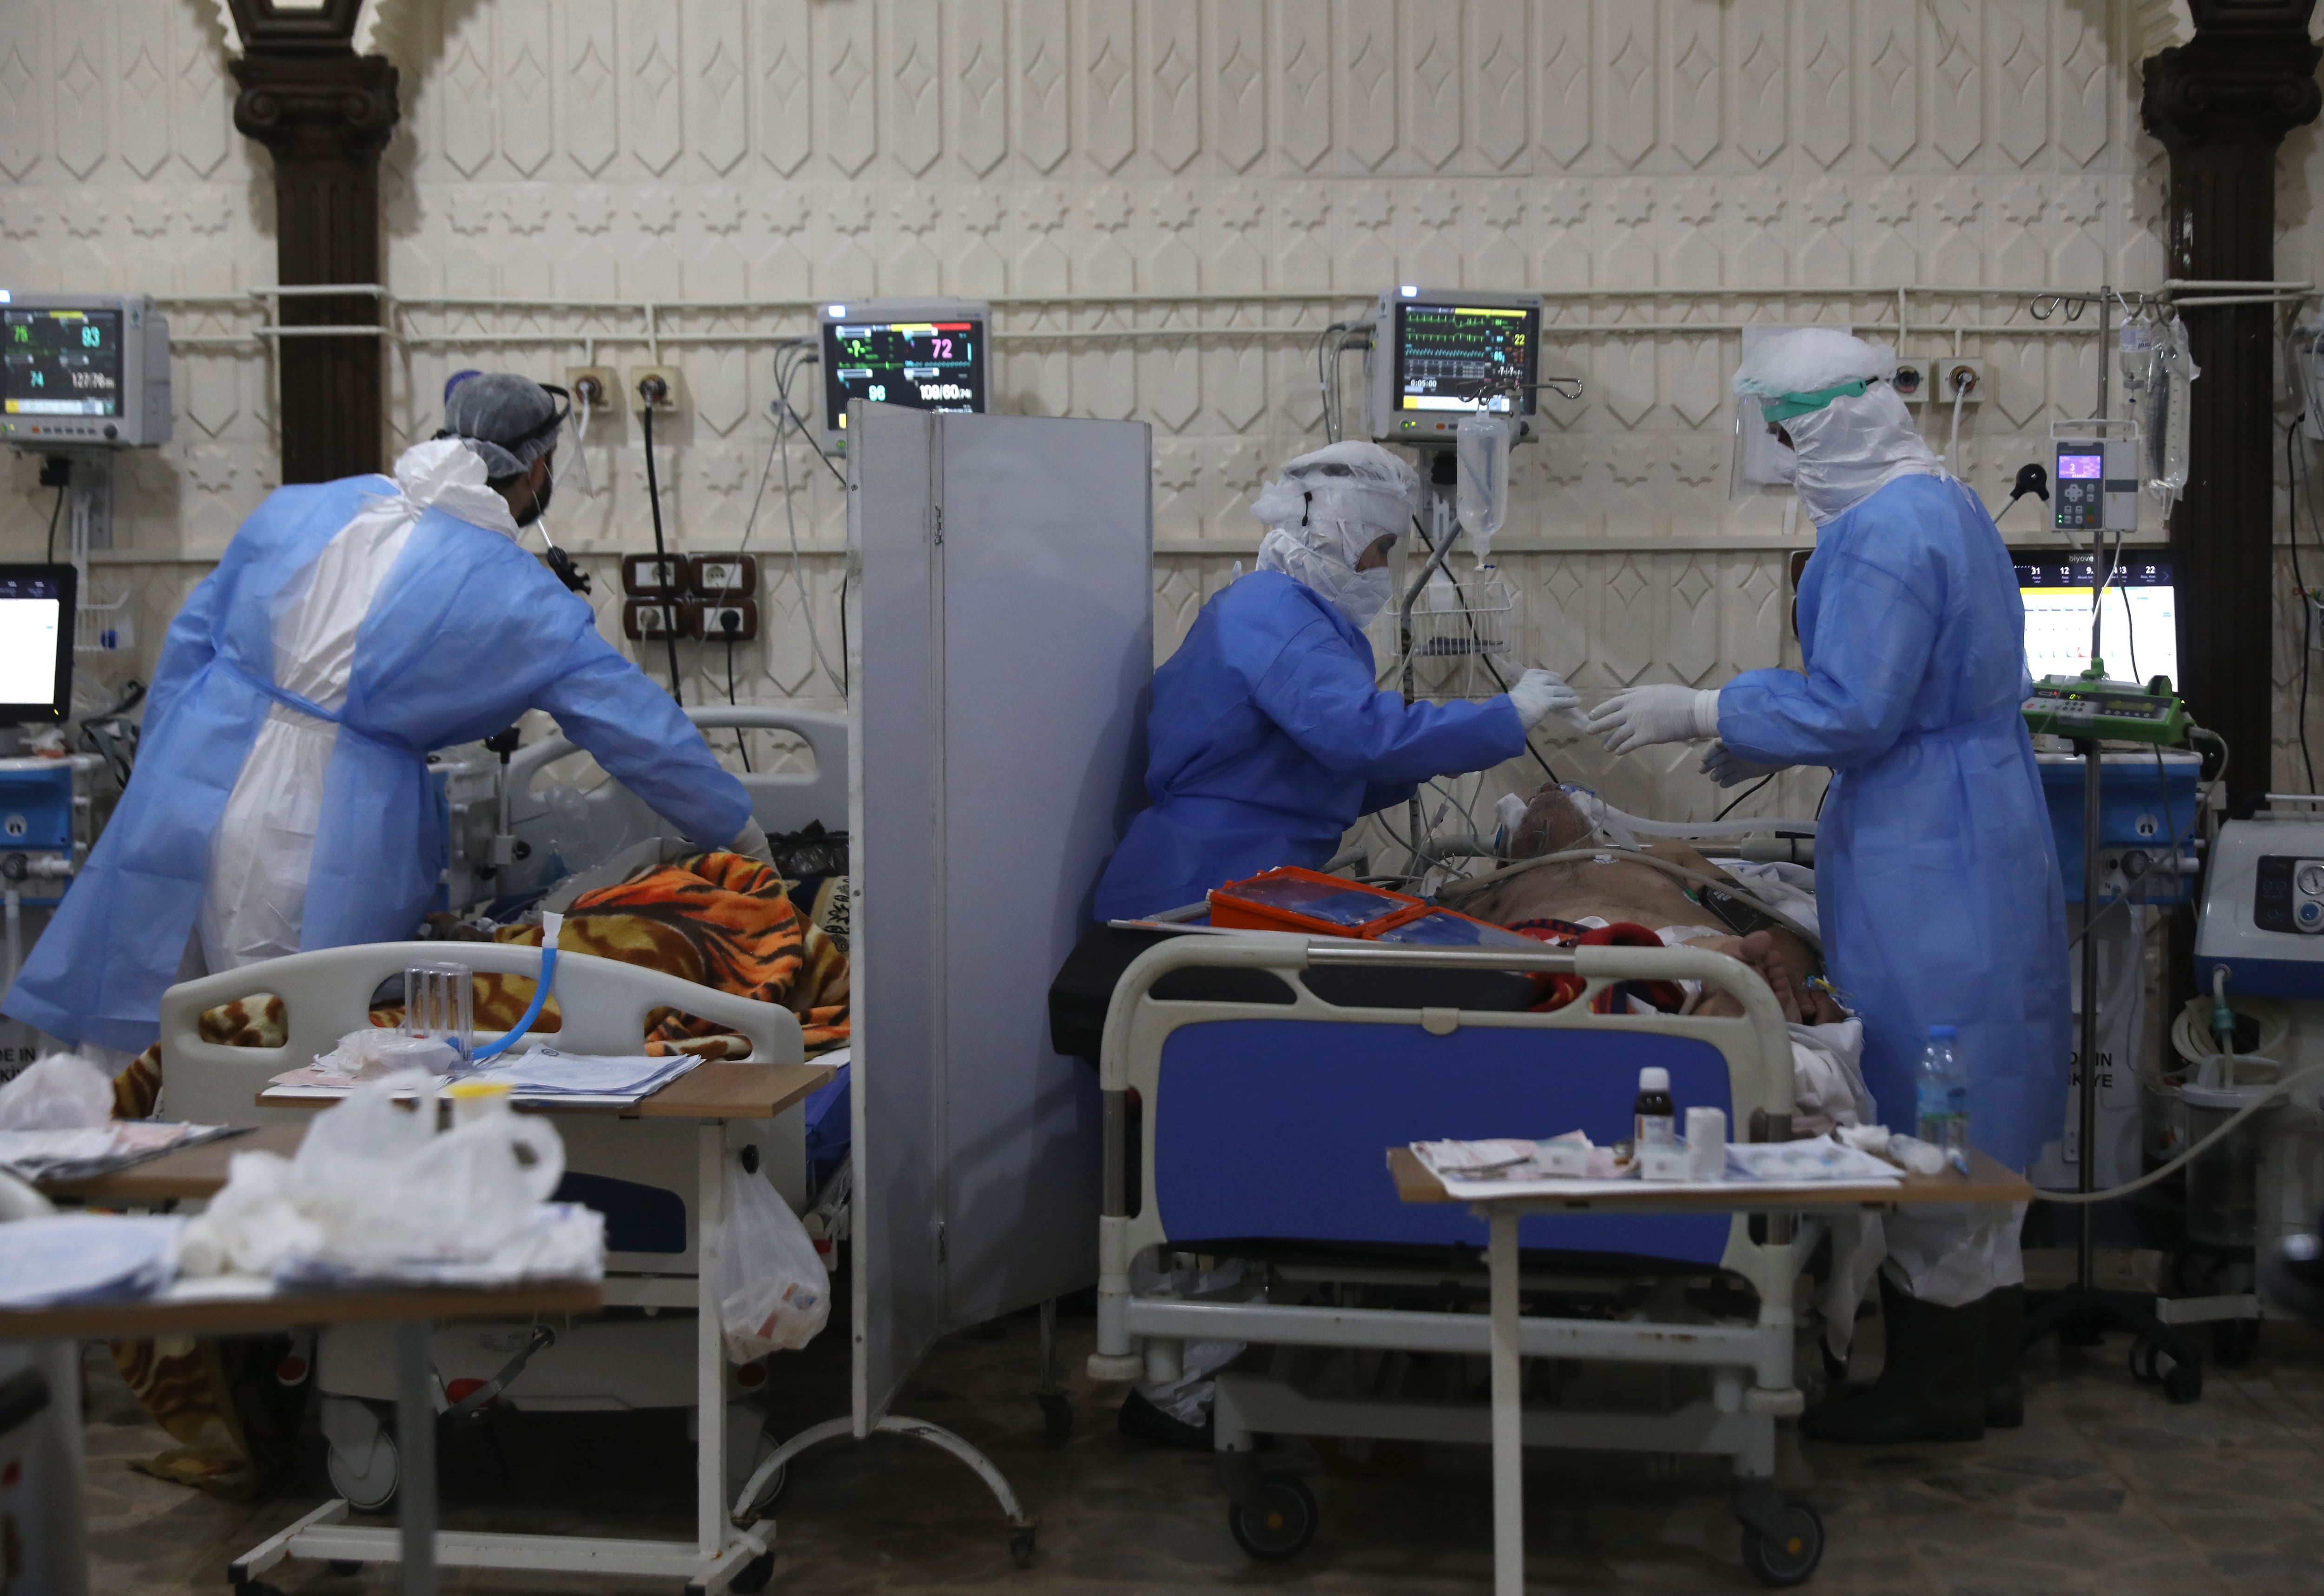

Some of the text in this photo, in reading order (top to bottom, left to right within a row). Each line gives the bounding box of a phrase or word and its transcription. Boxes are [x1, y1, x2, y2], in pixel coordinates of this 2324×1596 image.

[1514, 334, 1525, 346] 22
[931, 338, 953, 359] 72
[1411, 379, 1437, 387] 0:05:00
[2070, 463, 2075, 471] 3
[2031, 567, 2040, 575] 31
[2060, 566, 2070, 575] 12
[2146, 565, 2156, 574] 22
[20, 1046, 36, 1062] IN
[2095, 1053, 2112, 1066] IN
